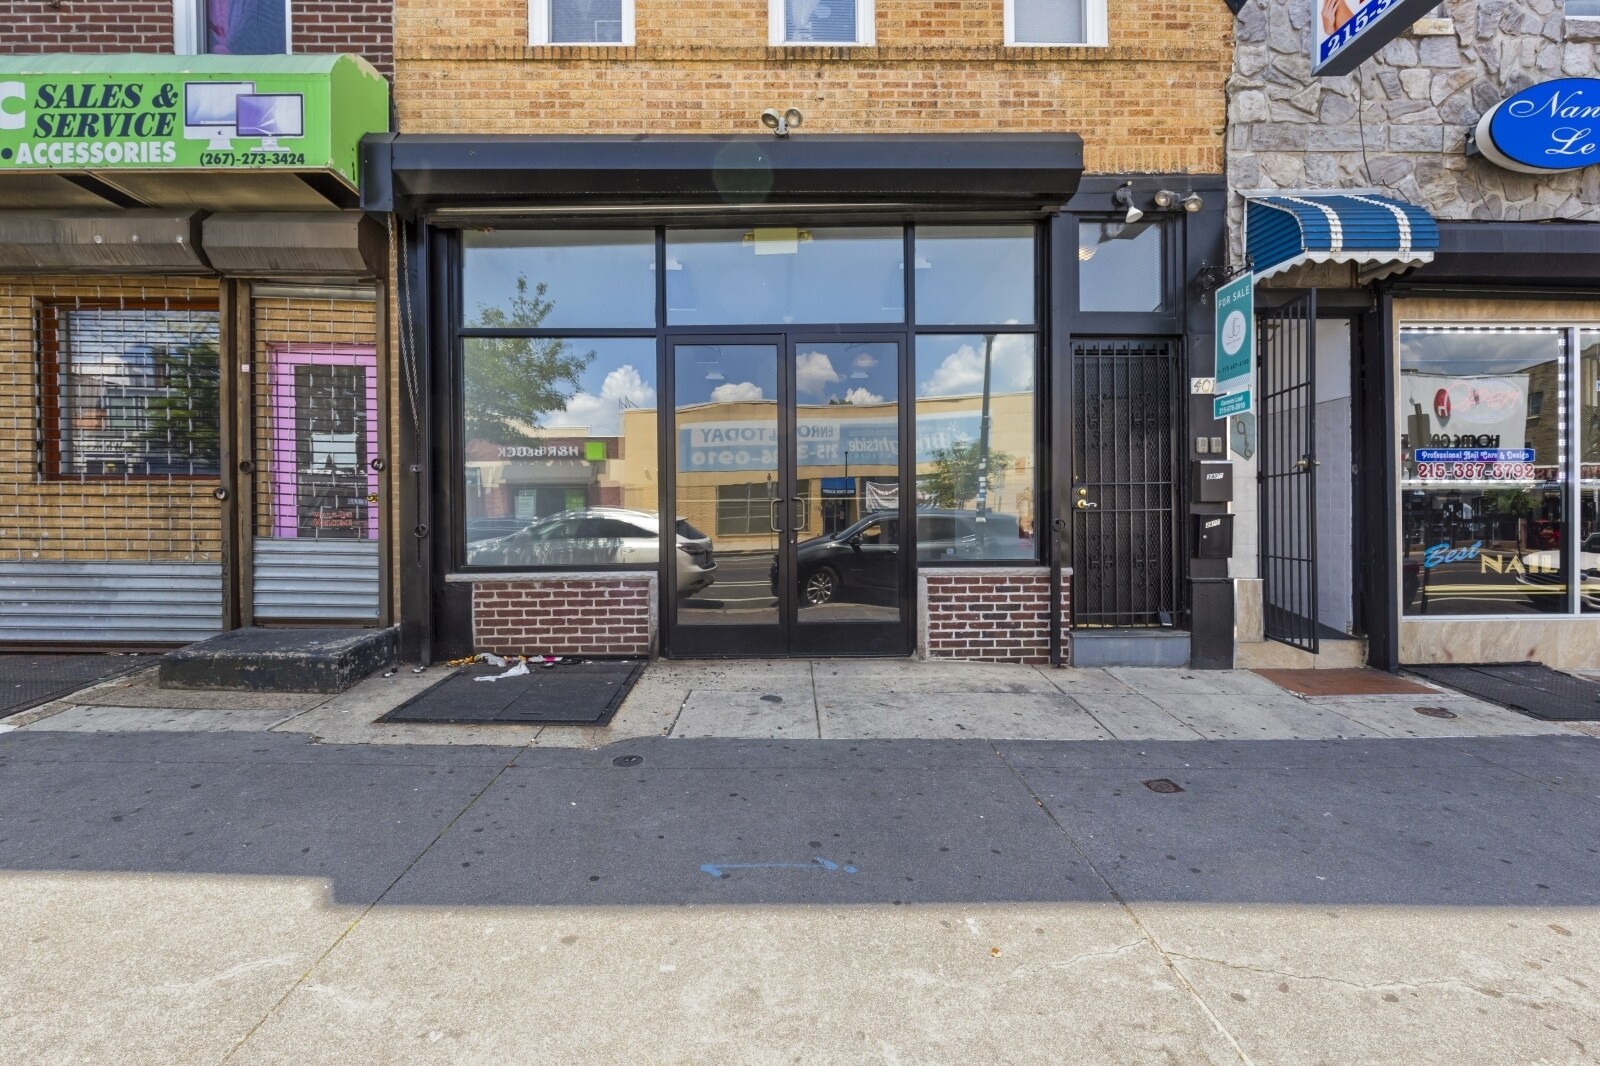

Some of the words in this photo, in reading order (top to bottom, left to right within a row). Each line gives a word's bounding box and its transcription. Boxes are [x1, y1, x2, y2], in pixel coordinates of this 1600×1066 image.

[33, 83, 144, 109] SALES
[152, 83, 179, 109] &
[33, 112, 177, 138] SERVICE
[15, 140, 177, 165] ACCESSORIES
[1545, 126, 1596, 155] Le
[200, 152, 305, 167] (267)-273-3424
[1218, 295, 1231, 309] FOR
[1232, 284, 1250, 302] SALE
[1421, 451, 1462, 460] Professional
[1463, 451, 1479, 460] Nail
[1481, 451, 1498, 460] Care
[1499, 451, 1505, 460] &
[1417, 462, 1535, 480] 215-387-3792
[1424, 540, 1482, 568] Best
[1480, 554, 1558, 574] NAIL
